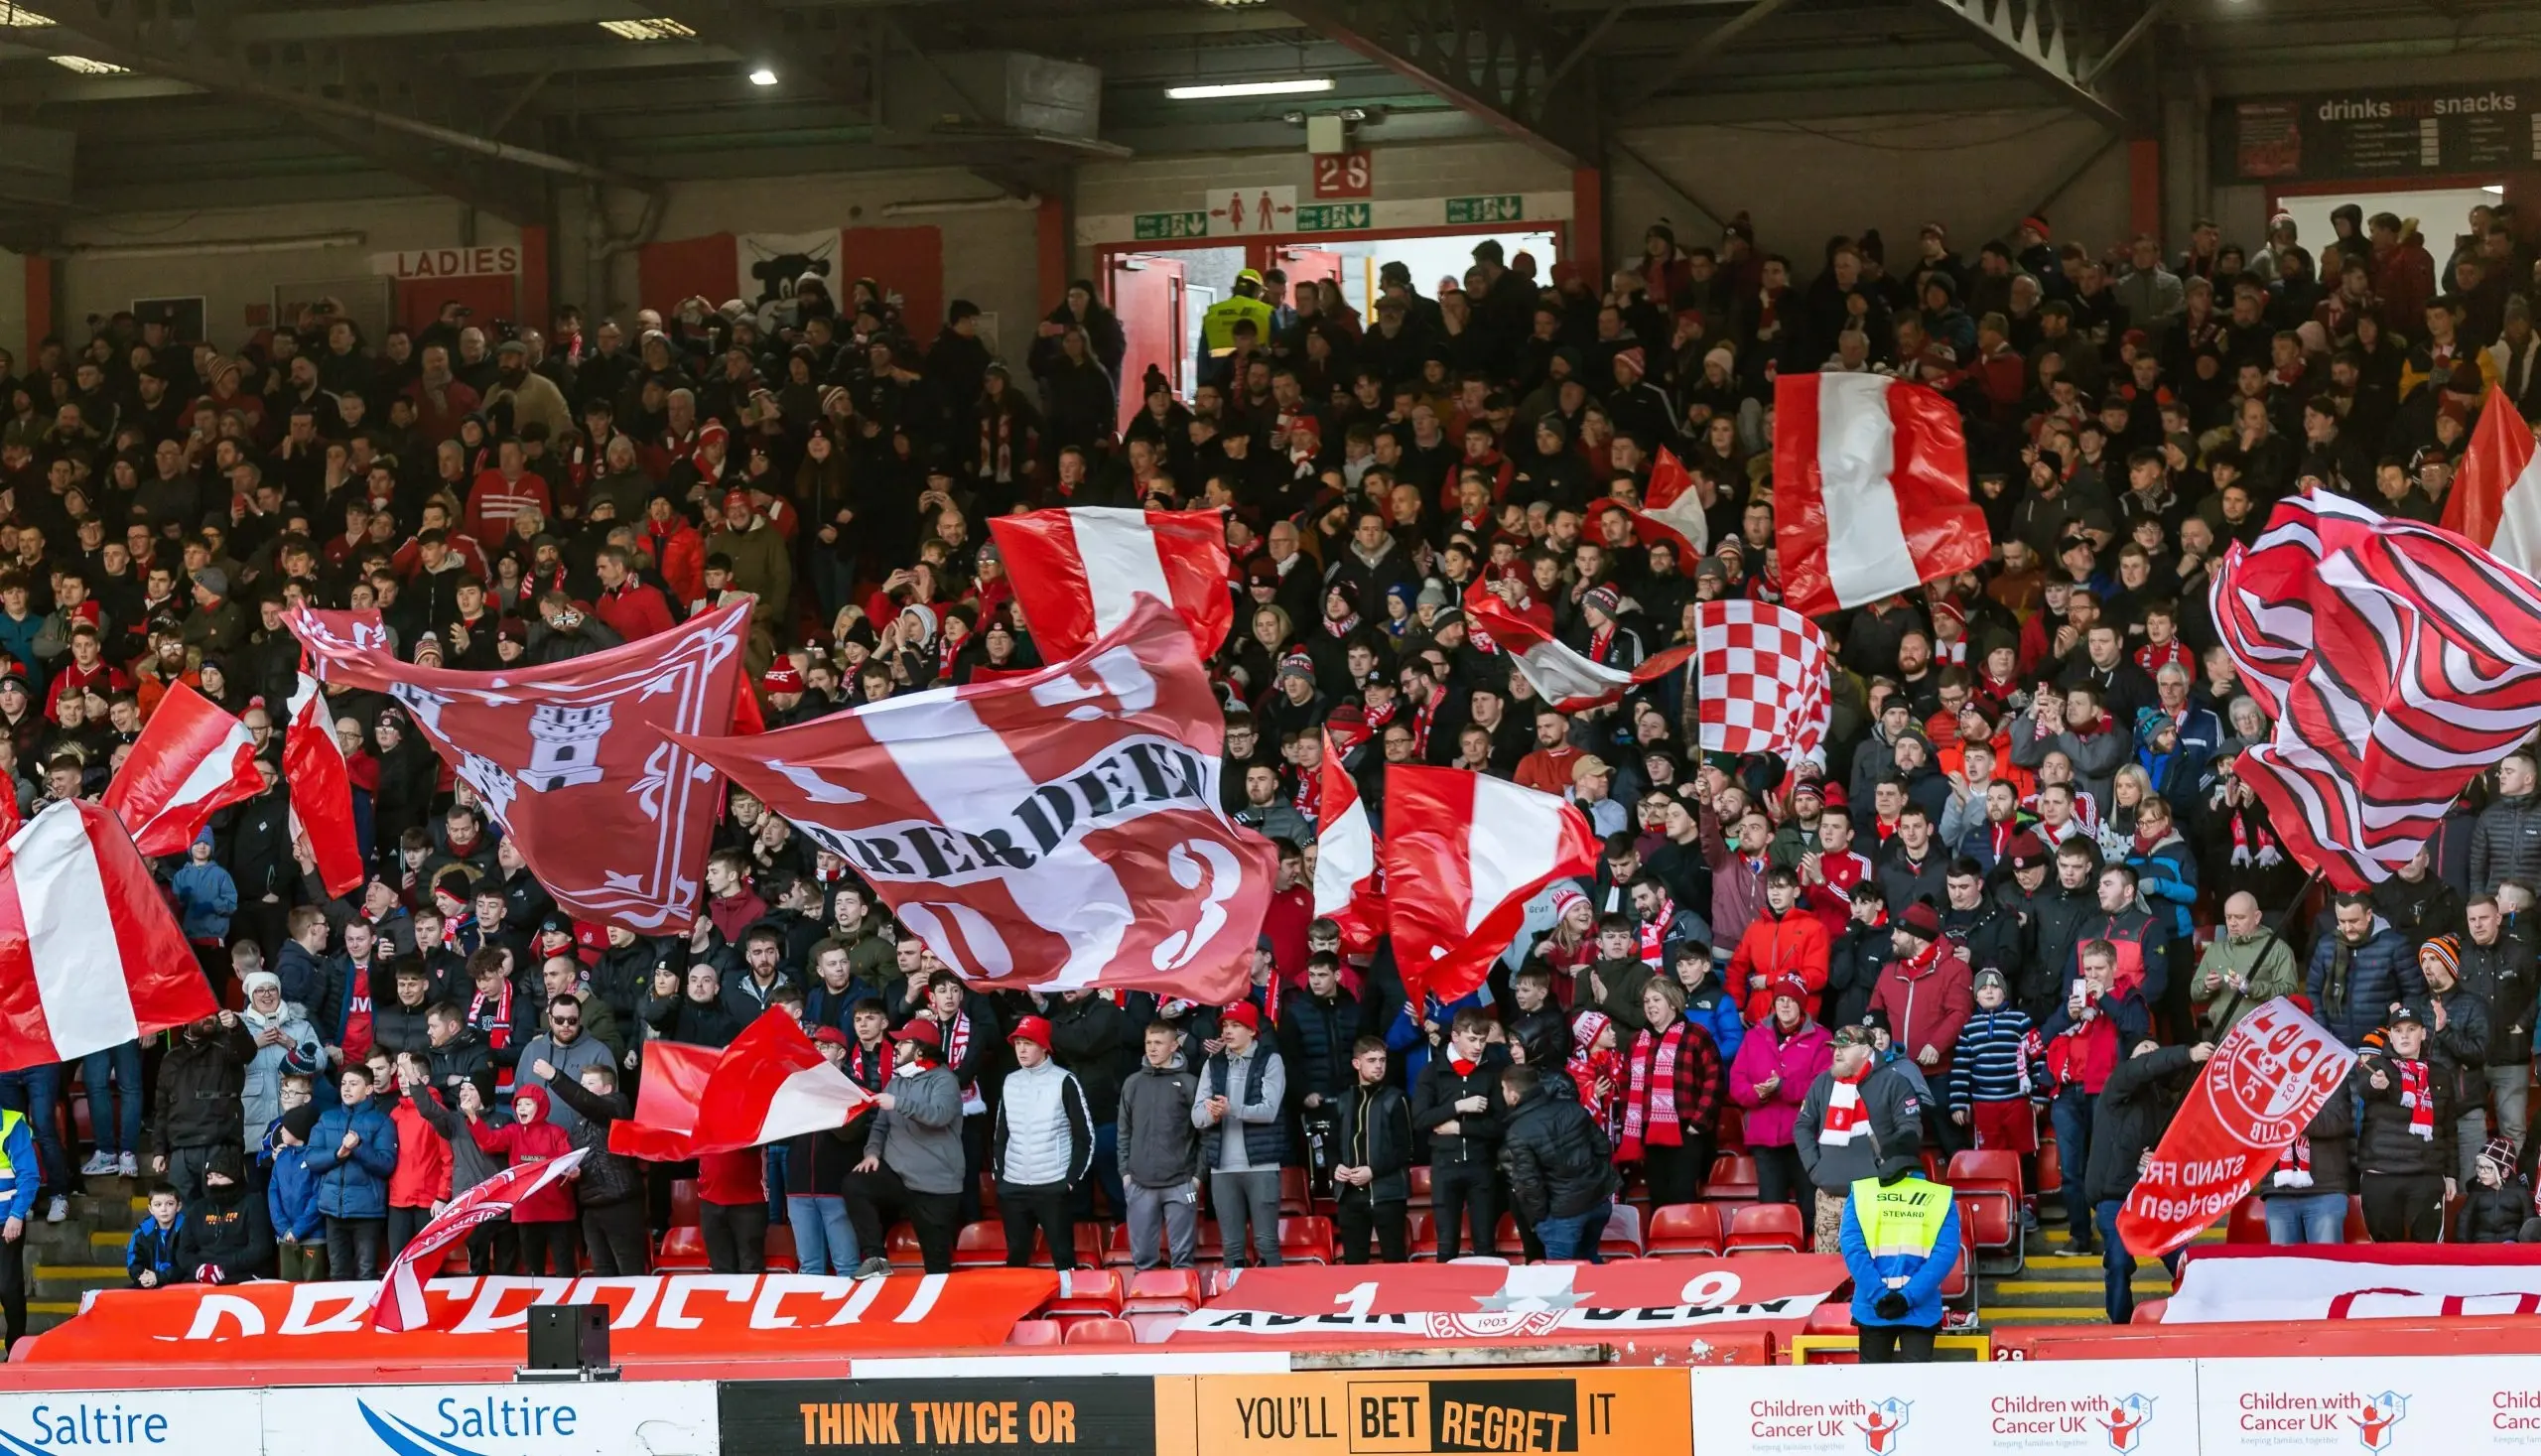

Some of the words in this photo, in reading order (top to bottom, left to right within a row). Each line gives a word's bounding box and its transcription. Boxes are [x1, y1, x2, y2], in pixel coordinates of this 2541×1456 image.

[2319, 99, 2392, 121] drinks
[2434, 91, 2517, 115] snacks
[398, 247, 517, 277] LADIES
[1876, 1193, 1908, 1202] SGL
[1882, 1210, 1925, 1219] STEWARD
[1335, 1281, 1379, 1315] 1
[1680, 1270, 1742, 1311] 9
[1478, 1317, 1509, 1328] 1903
[1750, 1400, 1826, 1418] Children
[1829, 1398, 1866, 1416] with
[1991, 1396, 2068, 1414] Children
[2071, 1394, 2109, 1412] with
[2239, 1392, 2317, 1410] Children
[2322, 1391, 2361, 1409] with
[2492, 1390, 2541, 1408] Child
[33, 1405, 168, 1446] Saltire
[438, 1396, 577, 1437] Saltire
[800, 1402, 901, 1445] THINK
[910, 1401, 1018, 1444] TWICE
[1028, 1400, 1076, 1443] OR
[1236, 1396, 1338, 1439] YOU'LL
[1361, 1396, 1420, 1438] BET
[1442, 1400, 1567, 1452] REGRET
[1589, 1392, 1616, 1435] IT
[1992, 1416, 2056, 1434] Cancer
[2059, 1416, 2086, 1433] UK
[2240, 1414, 2305, 1430] Cancer
[2310, 1413, 2339, 1430] UK
[2492, 1412, 2541, 1429] Canc
[1751, 1420, 1814, 1438] Cancer
[1817, 1419, 1845, 1437] UK
